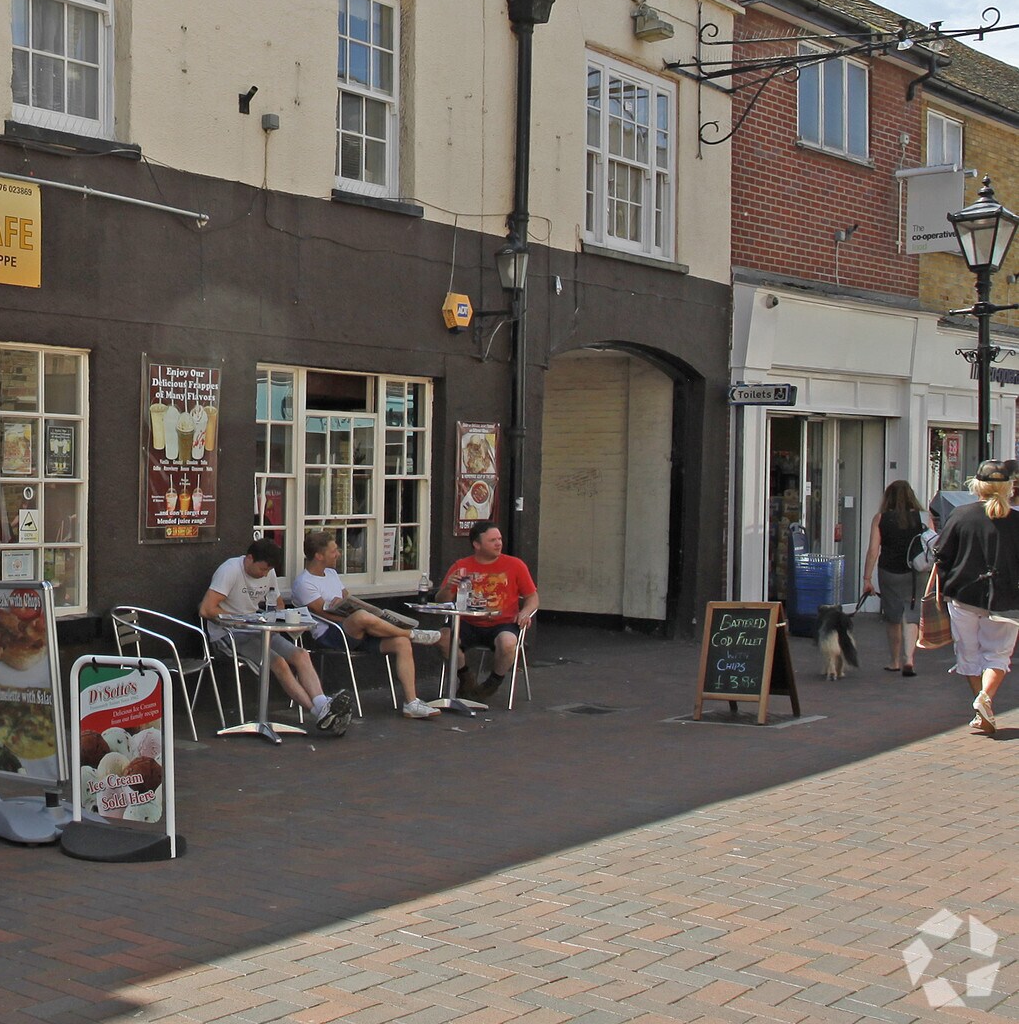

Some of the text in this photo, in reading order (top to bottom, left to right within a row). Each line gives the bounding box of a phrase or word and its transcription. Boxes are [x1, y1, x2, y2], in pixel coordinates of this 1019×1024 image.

[8, 182, 33, 196] 023869
[912, 224, 925, 232] The
[166, 367, 205, 378] Enjoy Our
[152, 378, 219, 391] Delicious Frappes
[155, 390, 216, 401] of Many Flavors
[738, 390, 772, 399] Toilets
[9, 593, 23, 607] with
[23, 592, 41, 610] Chips
[21, 689, 36, 704] with
[88, 773, 144, 794] Ice Cream
[101, 788, 156, 811] Sold Here
